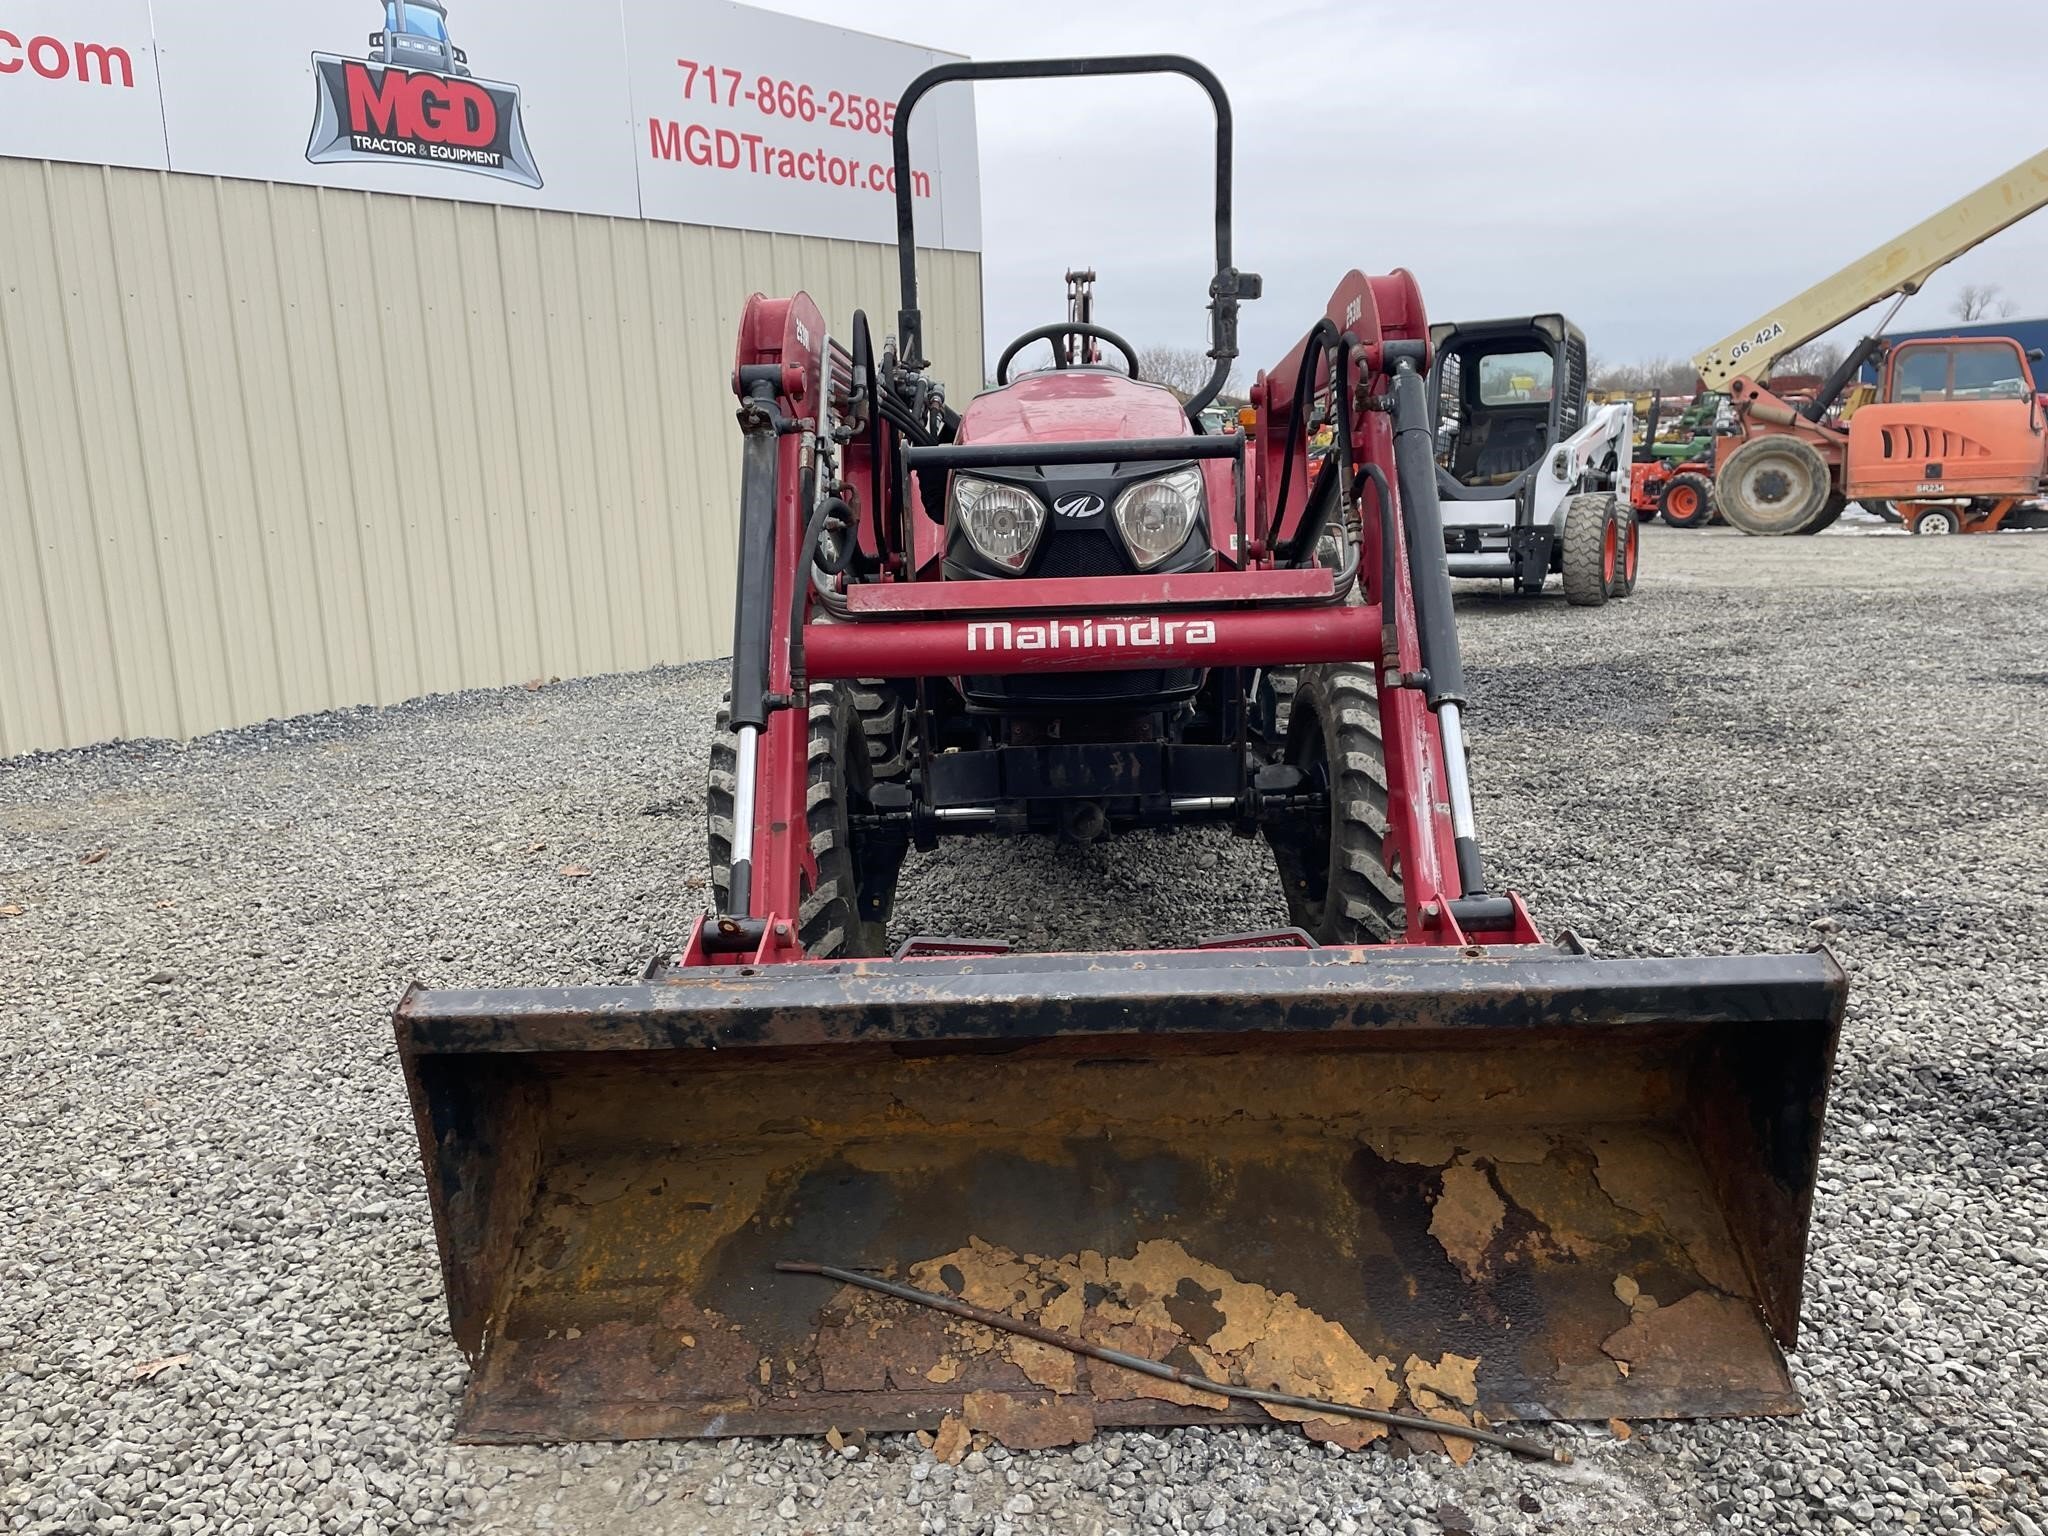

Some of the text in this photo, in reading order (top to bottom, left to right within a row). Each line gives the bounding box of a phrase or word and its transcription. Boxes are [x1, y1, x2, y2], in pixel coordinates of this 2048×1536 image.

[345, 62, 497, 148] MGD
[677, 58, 897, 137] 717-866-2585
[353, 135, 500, 166] TRACTOR & EQUIPMENT
[1731, 323, 1784, 358] G6-42A
[967, 617, 1216, 651] Mahindra
